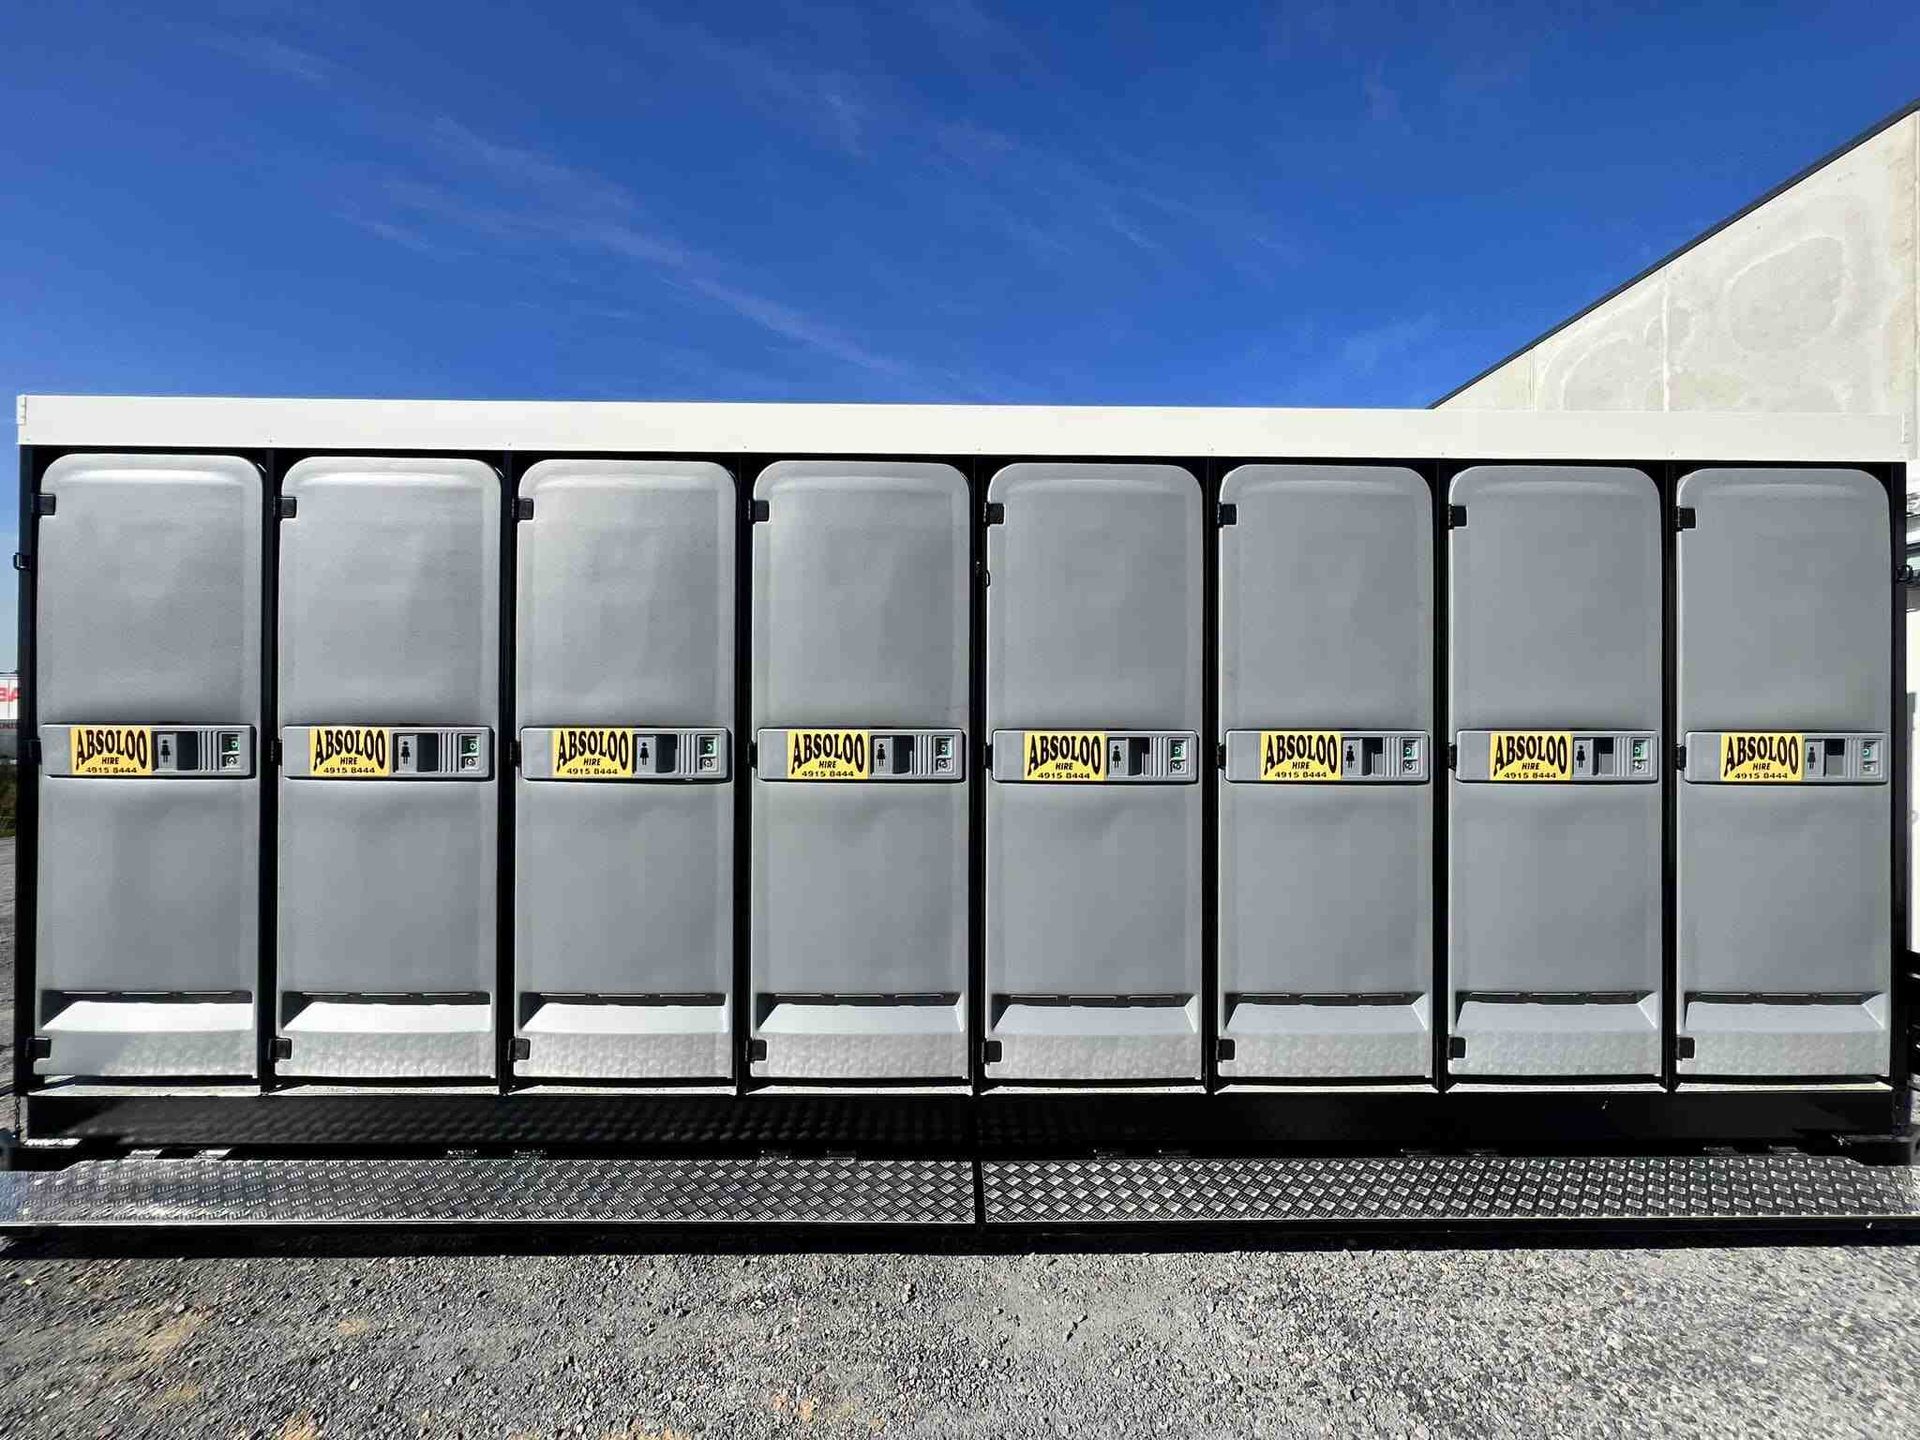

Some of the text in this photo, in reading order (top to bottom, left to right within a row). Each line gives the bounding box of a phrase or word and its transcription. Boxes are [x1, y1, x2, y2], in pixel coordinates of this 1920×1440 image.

[76, 729, 148, 771] ABSOLOO
[313, 731, 386, 772] ABSOLOO
[556, 730, 629, 773] ABSOLOO
[791, 733, 865, 776] ABSOLOO
[1264, 734, 1338, 776] ABSOLOO
[101, 756, 120, 765] HIRE
[1027, 734, 1102, 777] ABSOLOO
[1493, 735, 1568, 777] ABSOLOO
[1723, 736, 1799, 778] ABSOLOO
[339, 756, 358, 766] HIRE
[583, 757, 601, 766] HIRE
[819, 760, 837, 769] HIRE
[1291, 761, 1310, 770] HIRE
[1055, 762, 1074, 771] HIRE
[1521, 762, 1541, 771] HIRE
[1752, 762, 1771, 771] HIRE
[801, 770, 854, 778] 4915 8444
